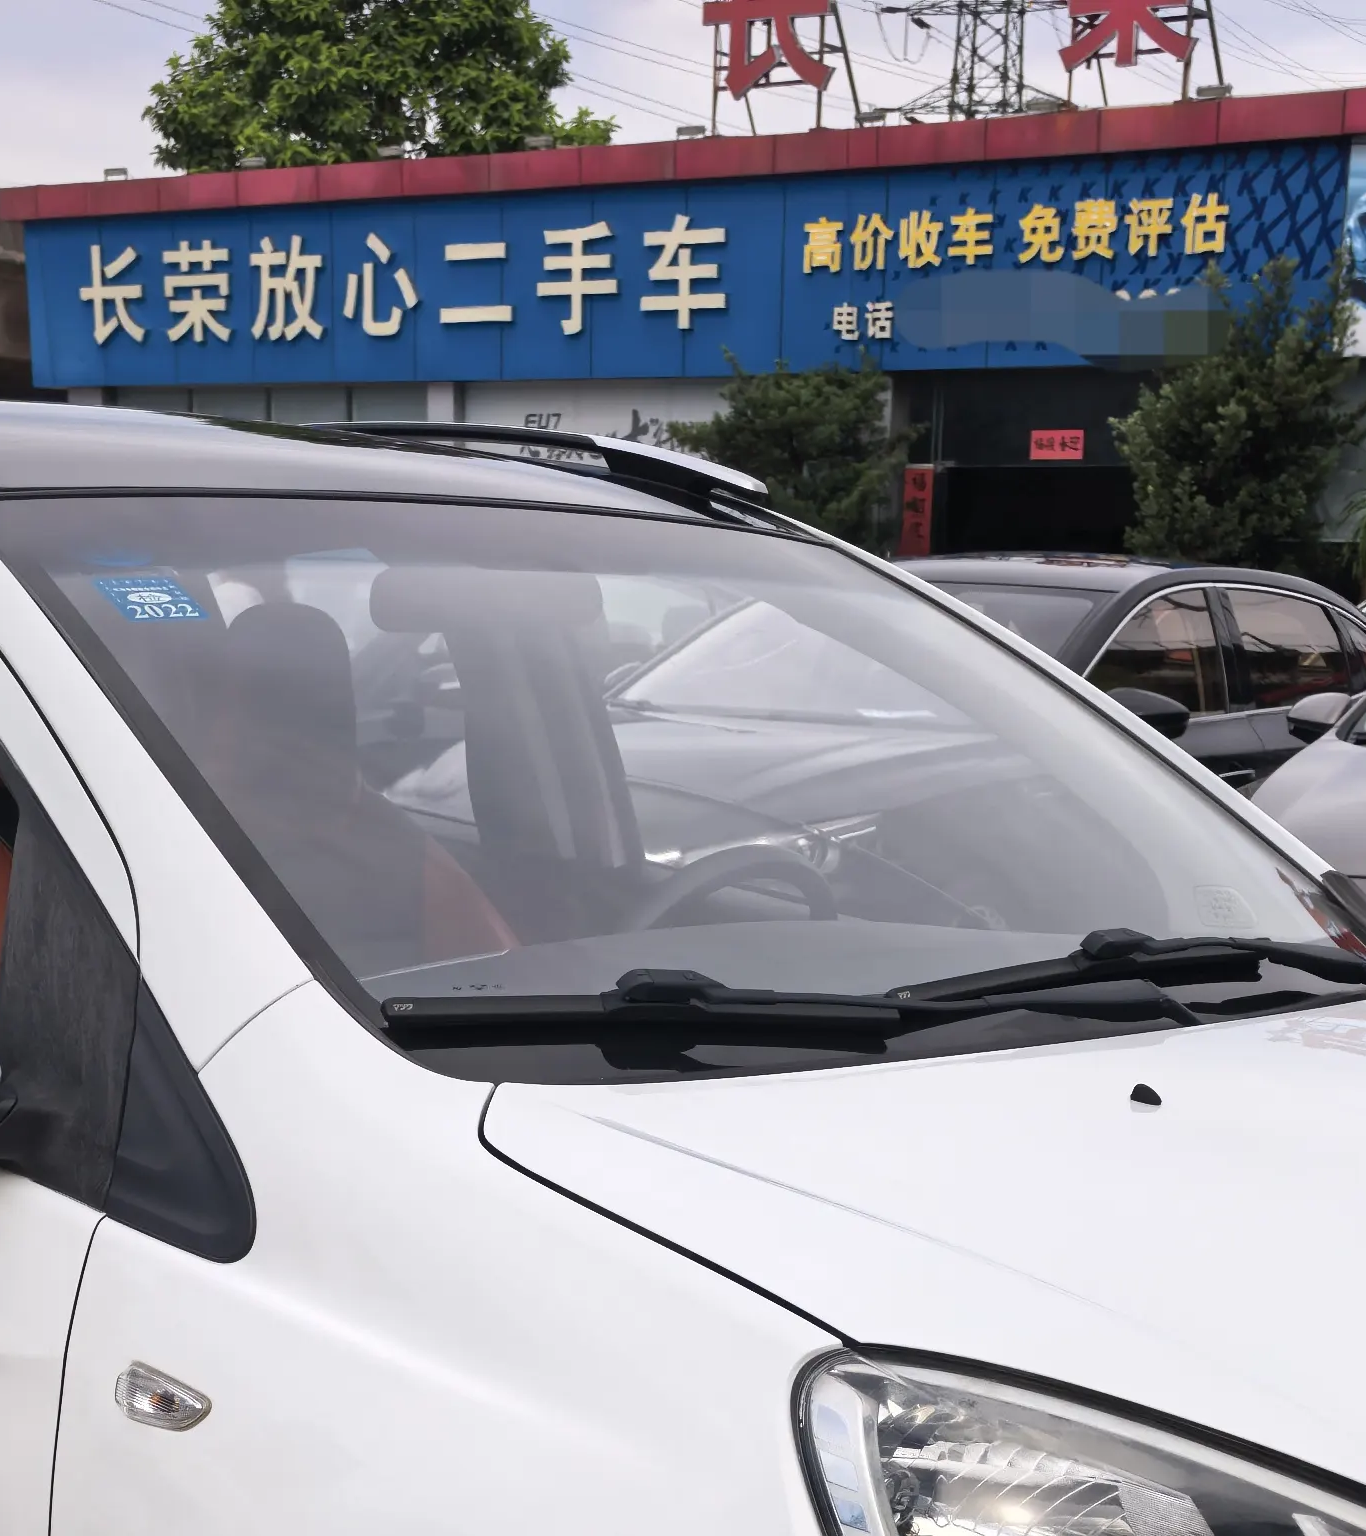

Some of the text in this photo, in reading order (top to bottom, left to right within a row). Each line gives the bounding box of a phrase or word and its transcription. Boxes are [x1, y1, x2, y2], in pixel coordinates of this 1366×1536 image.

[802, 192, 1231, 274] 高价收车 免费评估
[79, 213, 727, 347] 长荣放心二手车
[832, 301, 895, 341] 电话
[126, 602, 200, 619] 2022
